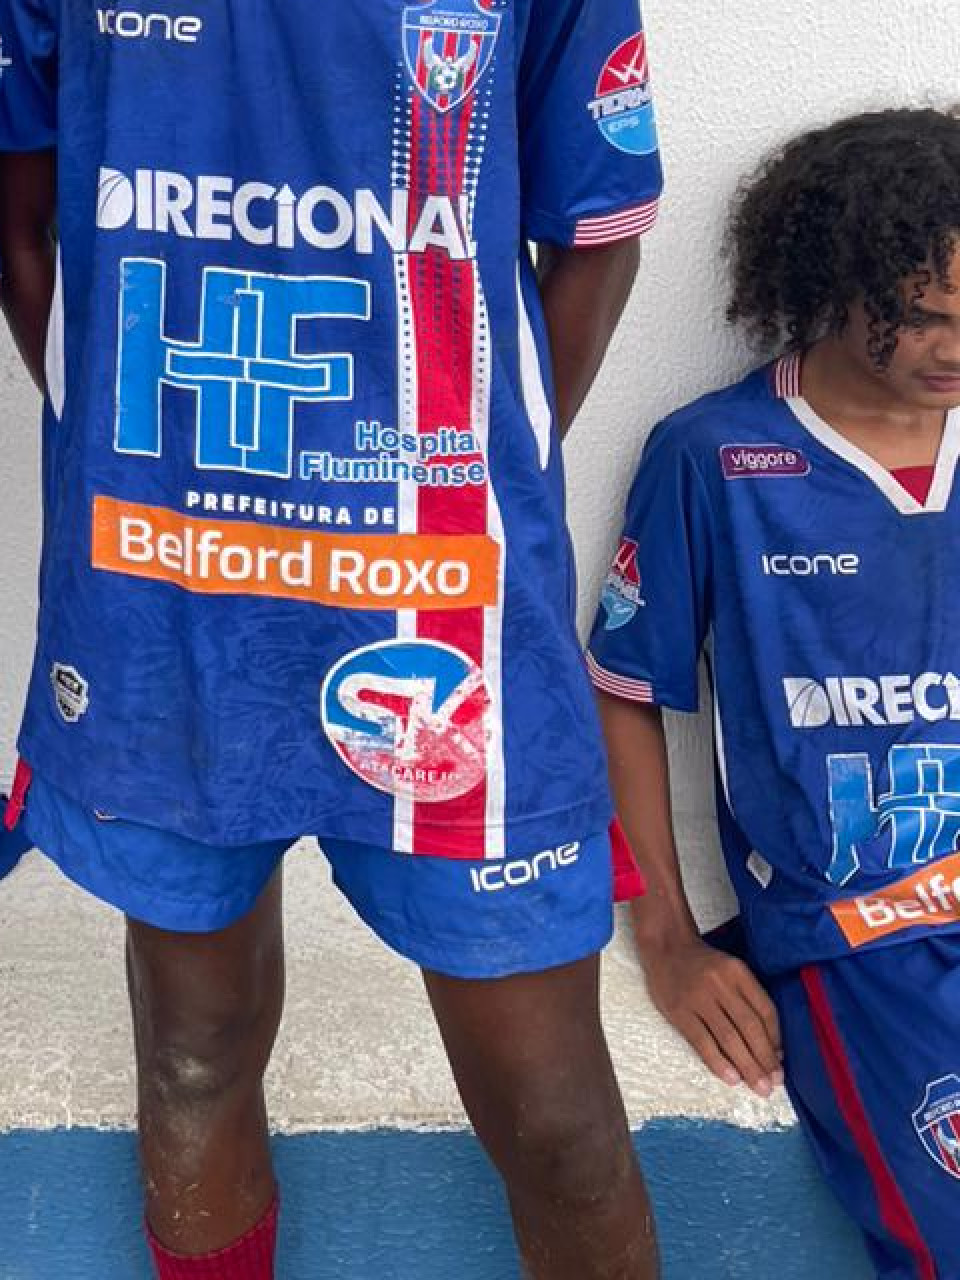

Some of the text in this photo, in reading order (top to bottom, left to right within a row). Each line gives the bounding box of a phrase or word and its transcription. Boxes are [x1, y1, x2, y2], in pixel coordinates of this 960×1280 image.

[300, 451, 486, 487] Fluminense
[731, 450, 797, 469] viggore
[186, 491, 396, 526] PREFEITURA DE
[119, 516, 470, 597] Belford Roxo
